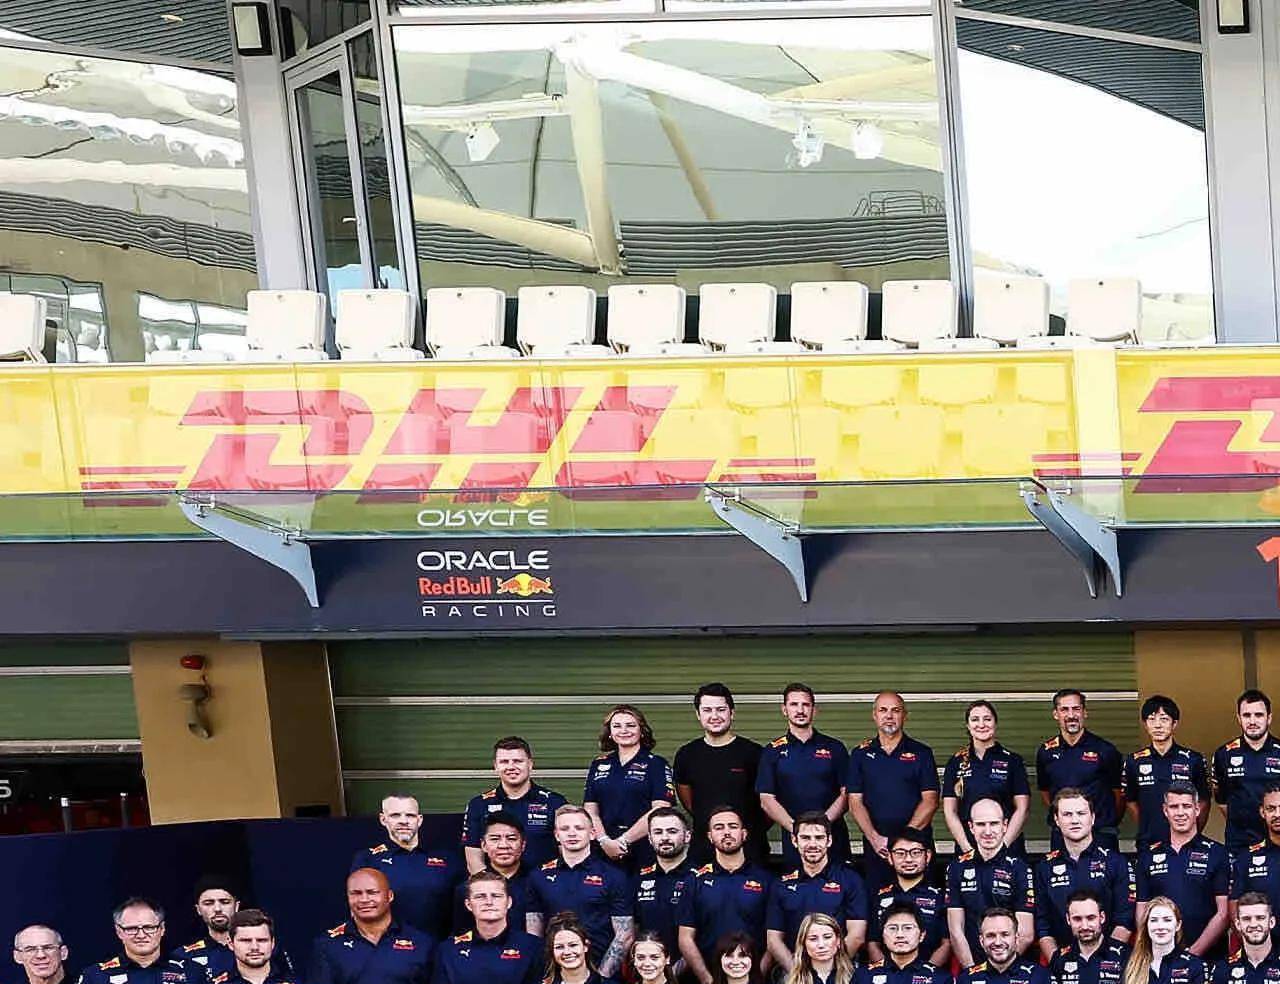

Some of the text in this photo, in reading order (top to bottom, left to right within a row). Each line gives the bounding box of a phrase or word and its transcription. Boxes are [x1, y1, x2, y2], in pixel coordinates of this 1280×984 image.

[179, 385, 719, 504] DHL
[417, 550, 550, 571] ORACLE
[422, 605, 556, 617] RACING
